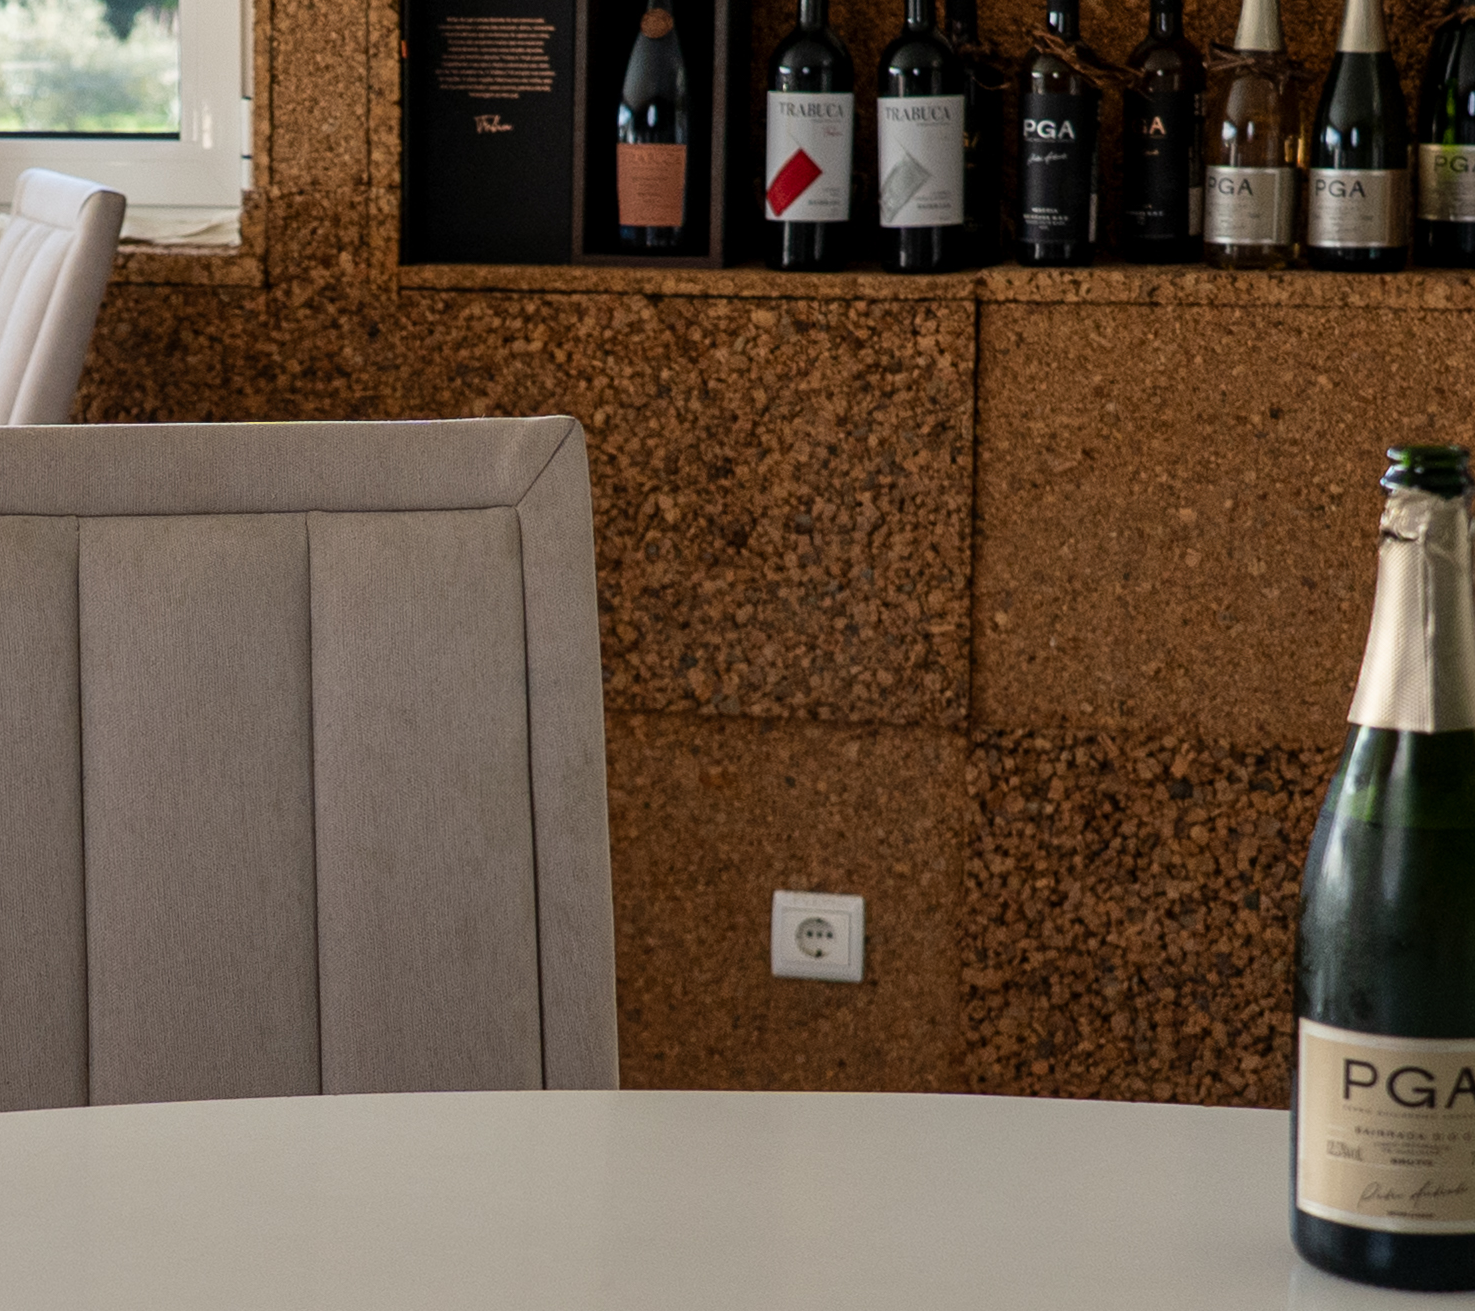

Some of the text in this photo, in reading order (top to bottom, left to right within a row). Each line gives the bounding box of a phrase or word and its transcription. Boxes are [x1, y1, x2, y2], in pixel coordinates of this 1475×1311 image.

[779, 101, 844, 118] TRABUCA
[885, 106, 950, 122] TRABUCA
[1023, 119, 1076, 140] PGA
[1208, 176, 1253, 197] PGA
[1315, 178, 1366, 199] PGA
